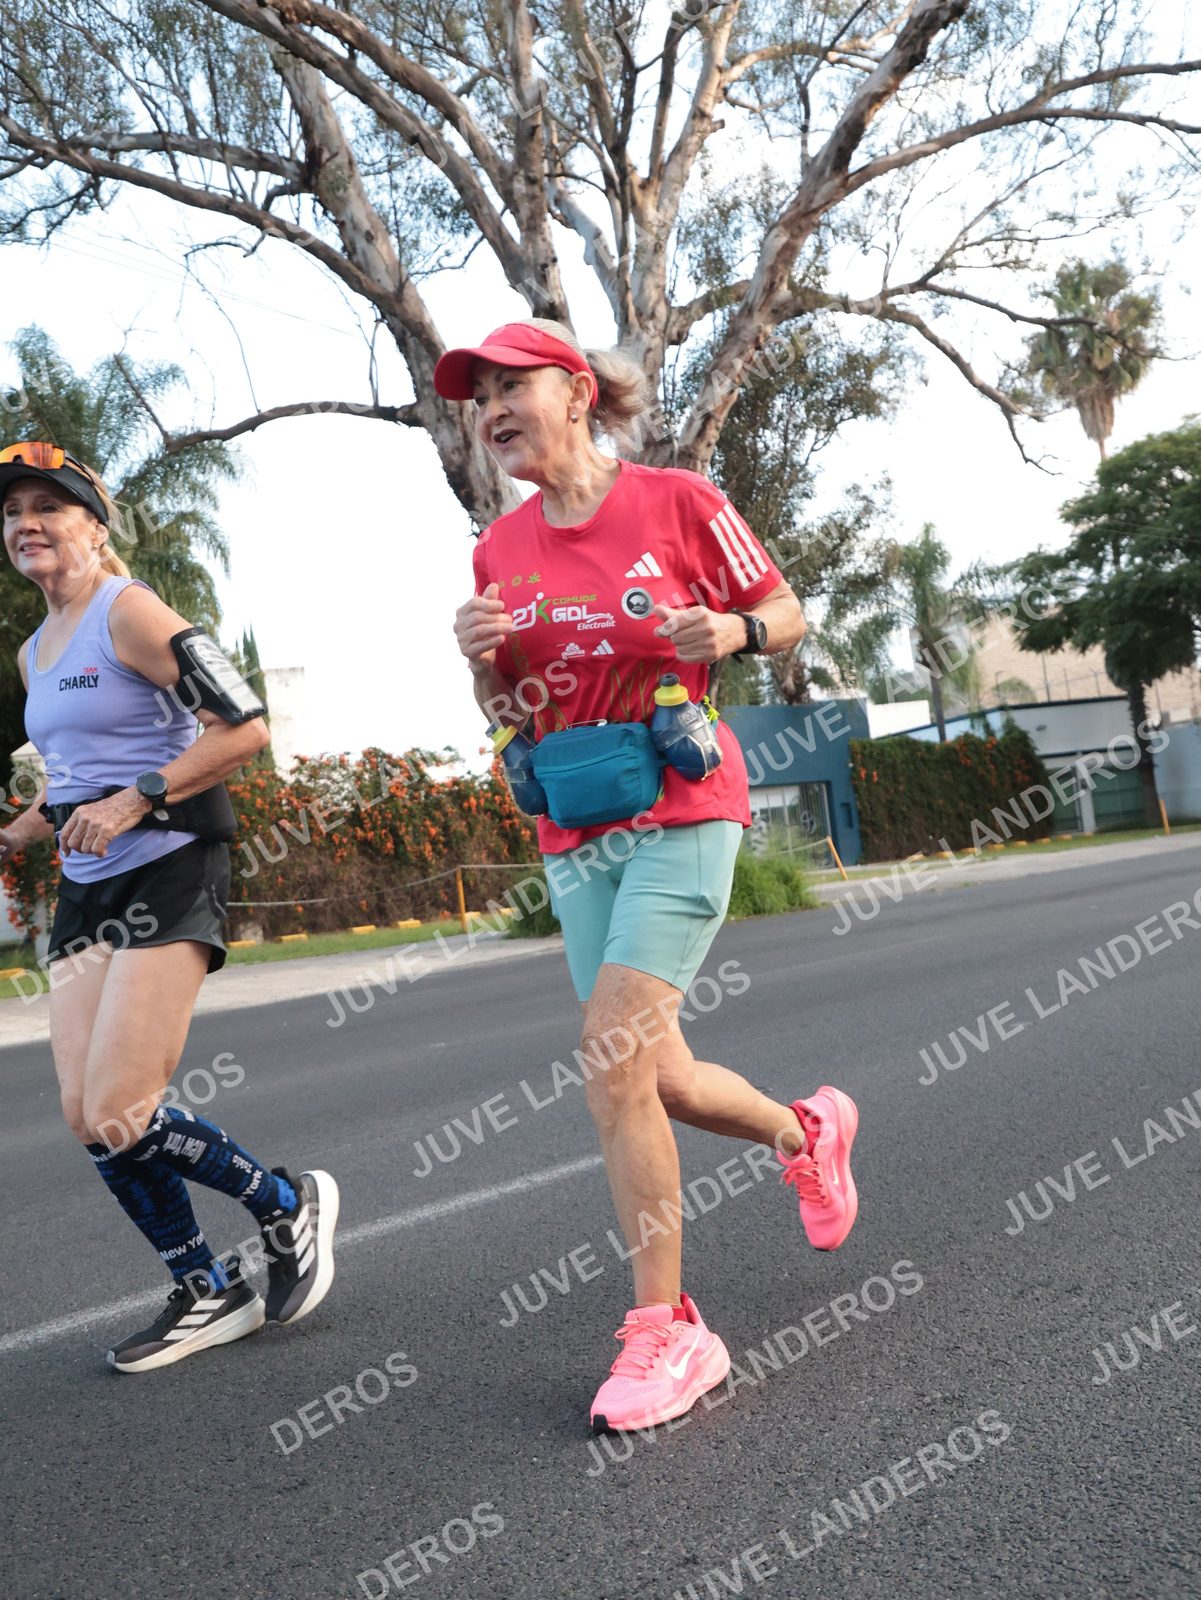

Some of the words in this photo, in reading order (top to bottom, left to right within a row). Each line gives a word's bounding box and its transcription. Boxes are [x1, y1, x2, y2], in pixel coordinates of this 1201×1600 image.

[552, 594, 597, 606] COMUDE
[552, 605, 596, 623] GDL
[577, 620, 617, 631] Electrolit
[59, 674, 99, 691] CHARLY
[242, 1170, 263, 1197] York
[159, 1244, 187, 1262] New
